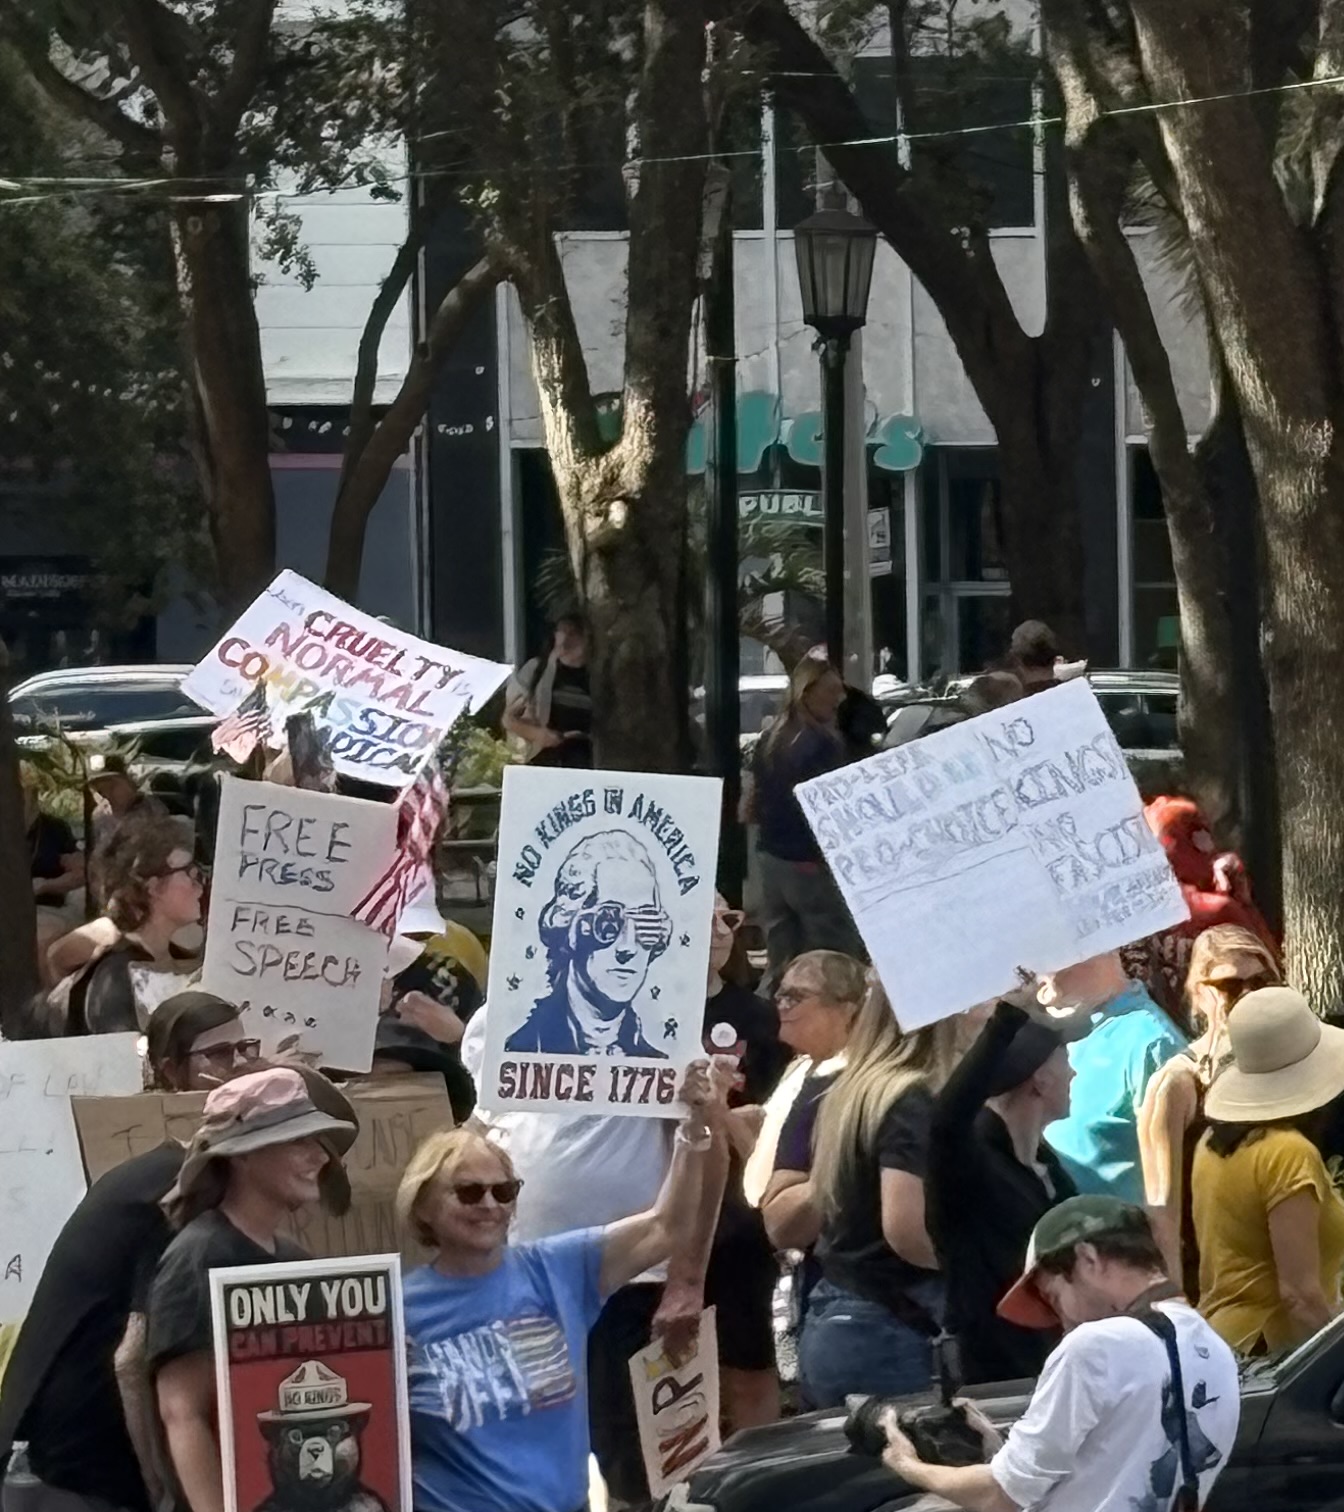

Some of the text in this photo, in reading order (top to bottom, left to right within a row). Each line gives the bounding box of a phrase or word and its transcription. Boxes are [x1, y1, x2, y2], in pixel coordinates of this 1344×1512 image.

[265, 622, 433, 716] NORMAL
[304, 610, 464, 689] CRUELTY
[240, 805, 351, 864] FREE
[513, 845, 543, 888] NO
[534, 788, 596, 850] KINGS
[627, 793, 701, 896] AMERICA
[239, 852, 335, 893] PRESS
[231, 905, 315, 937] FREE
[232, 940, 362, 988] SPEECH
[498, 1062, 676, 1104] SINCE 1776
[231, 1276, 386, 1328] ONLY YOU
[232, 1319, 391, 1359] CAN PREVENT
